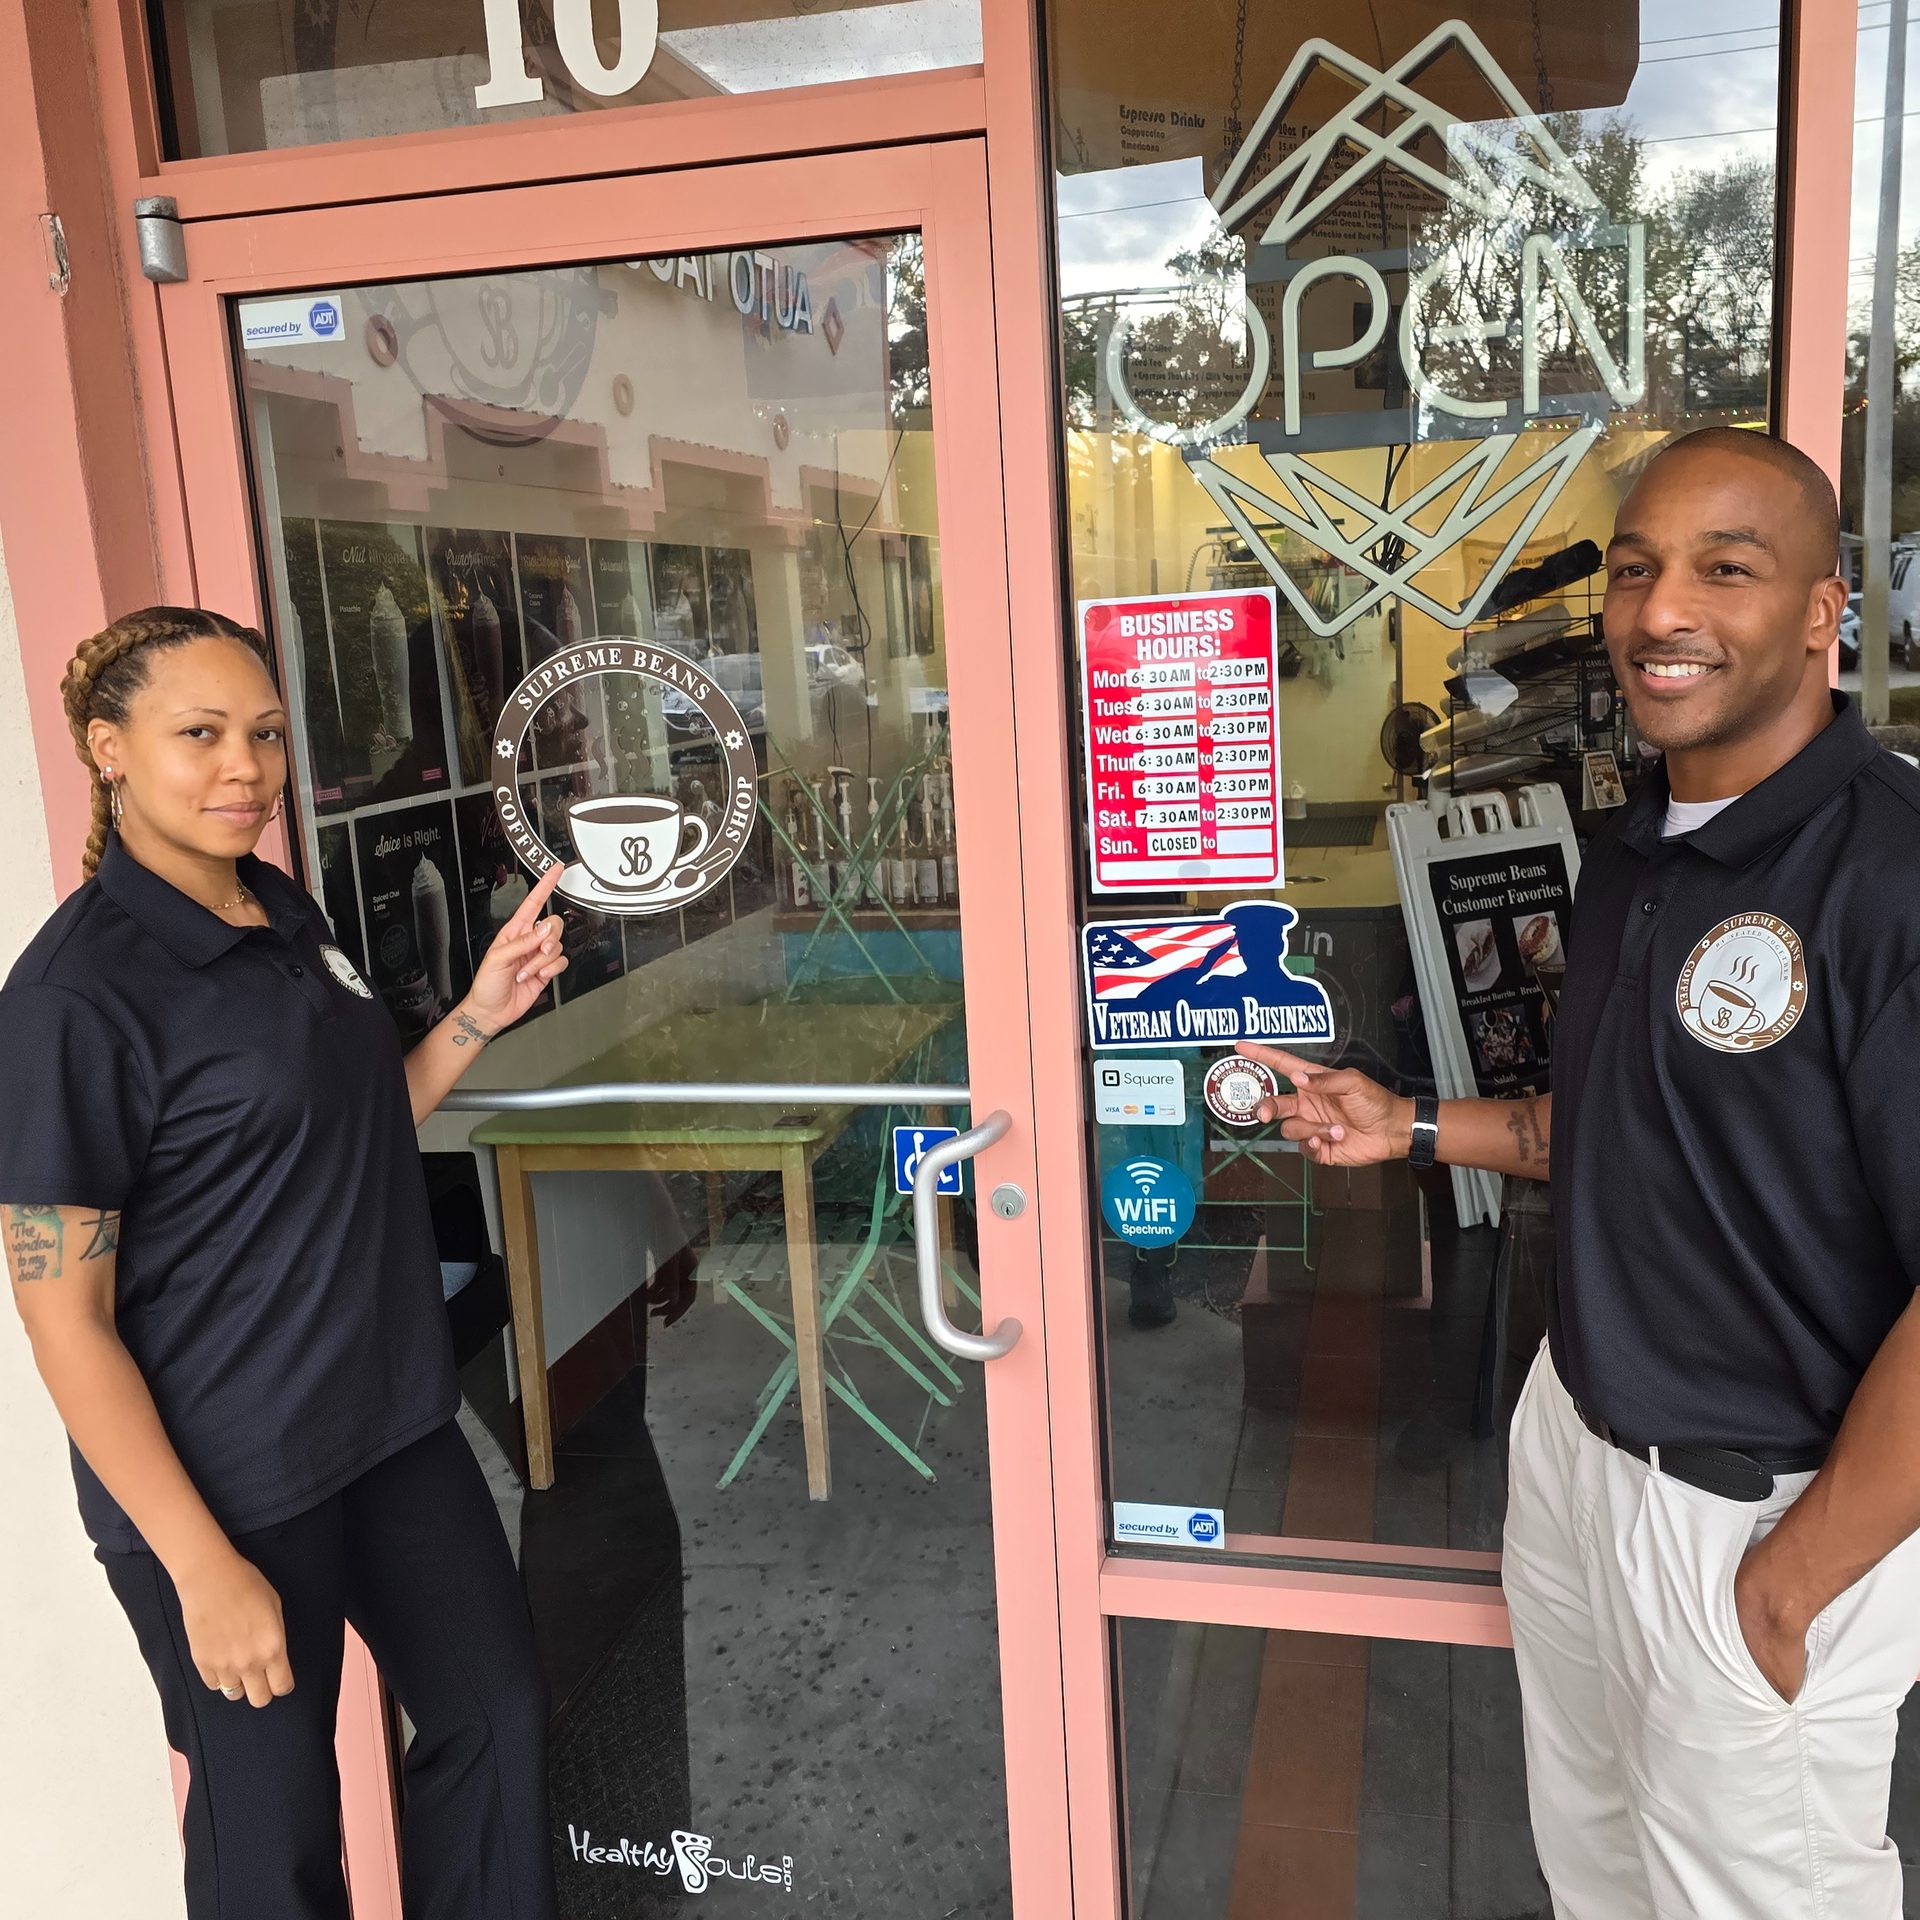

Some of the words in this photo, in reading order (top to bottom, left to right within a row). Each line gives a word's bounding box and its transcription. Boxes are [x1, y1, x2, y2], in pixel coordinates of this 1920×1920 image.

[1119, 105, 1166, 123] Espresso
[1170, 111, 1206, 128] Drinks
[246, 321, 288, 336] secured
[288, 321, 301, 333] by
[314, 311, 334, 326] ADT
[1106, 221, 1647, 445] OPEN
[342, 545, 367, 564] Nut
[1119, 608, 1235, 637] BUSINESS
[1136, 636, 1222, 661] HOURS:
[517, 646, 623, 711] SUPREME
[632, 648, 711, 701] BEANS
[1197, 667, 1210, 680] to
[1197, 695, 1211, 709] to
[1198, 724, 1211, 738] to
[1200, 753, 1213, 766] to
[1097, 781, 1126, 800] Fri.
[1200, 781, 1213, 794] to
[727, 776, 754, 844] SHOP
[1098, 809, 1132, 828] Sat.
[1201, 809, 1215, 822] to
[496, 785, 554, 874] COFFEE
[374, 834, 402, 859] Spice
[1100, 836, 1138, 855] Sun.
[1152, 836, 1198, 852] CLOSED
[1202, 836, 1216, 850] to
[1448, 869, 1508, 893] Supreme
[1508, 863, 1547, 882] Beans
[1441, 892, 1506, 916] Customer
[1506, 882, 1564, 908] Favorites
[1723, 914, 1777, 932] SUPREME
[1776, 926, 1801, 962] BEANS
[1679, 960, 1695, 1009] COFFEE
[1093, 1002, 1172, 1040] VETERAN
[1176, 999, 1240, 1038] OWNED
[1242, 996, 1327, 1036] BUSINESS
[1772, 1003, 1800, 1035] SHOP
[1123, 1072, 1175, 1088] Square
[1210, 1060, 1237, 1082] ORDER
[1238, 1060, 1269, 1081] ONLINE
[1104, 1106, 1121, 1114] VISA
[1114, 1197, 1177, 1223] WiFi
[10, 1222, 37, 1239] The
[1121, 1223, 1172, 1237] Spectrum
[12, 1232, 56, 1252] window
[17, 1254, 27, 1269] to
[28, 1256, 47, 1272] my
[1118, 1522, 1164, 1533] secured
[1165, 1524, 1179, 1536] by
[1192, 1521, 1215, 1534] ADT
[567, 1823, 675, 1876] Healthy
